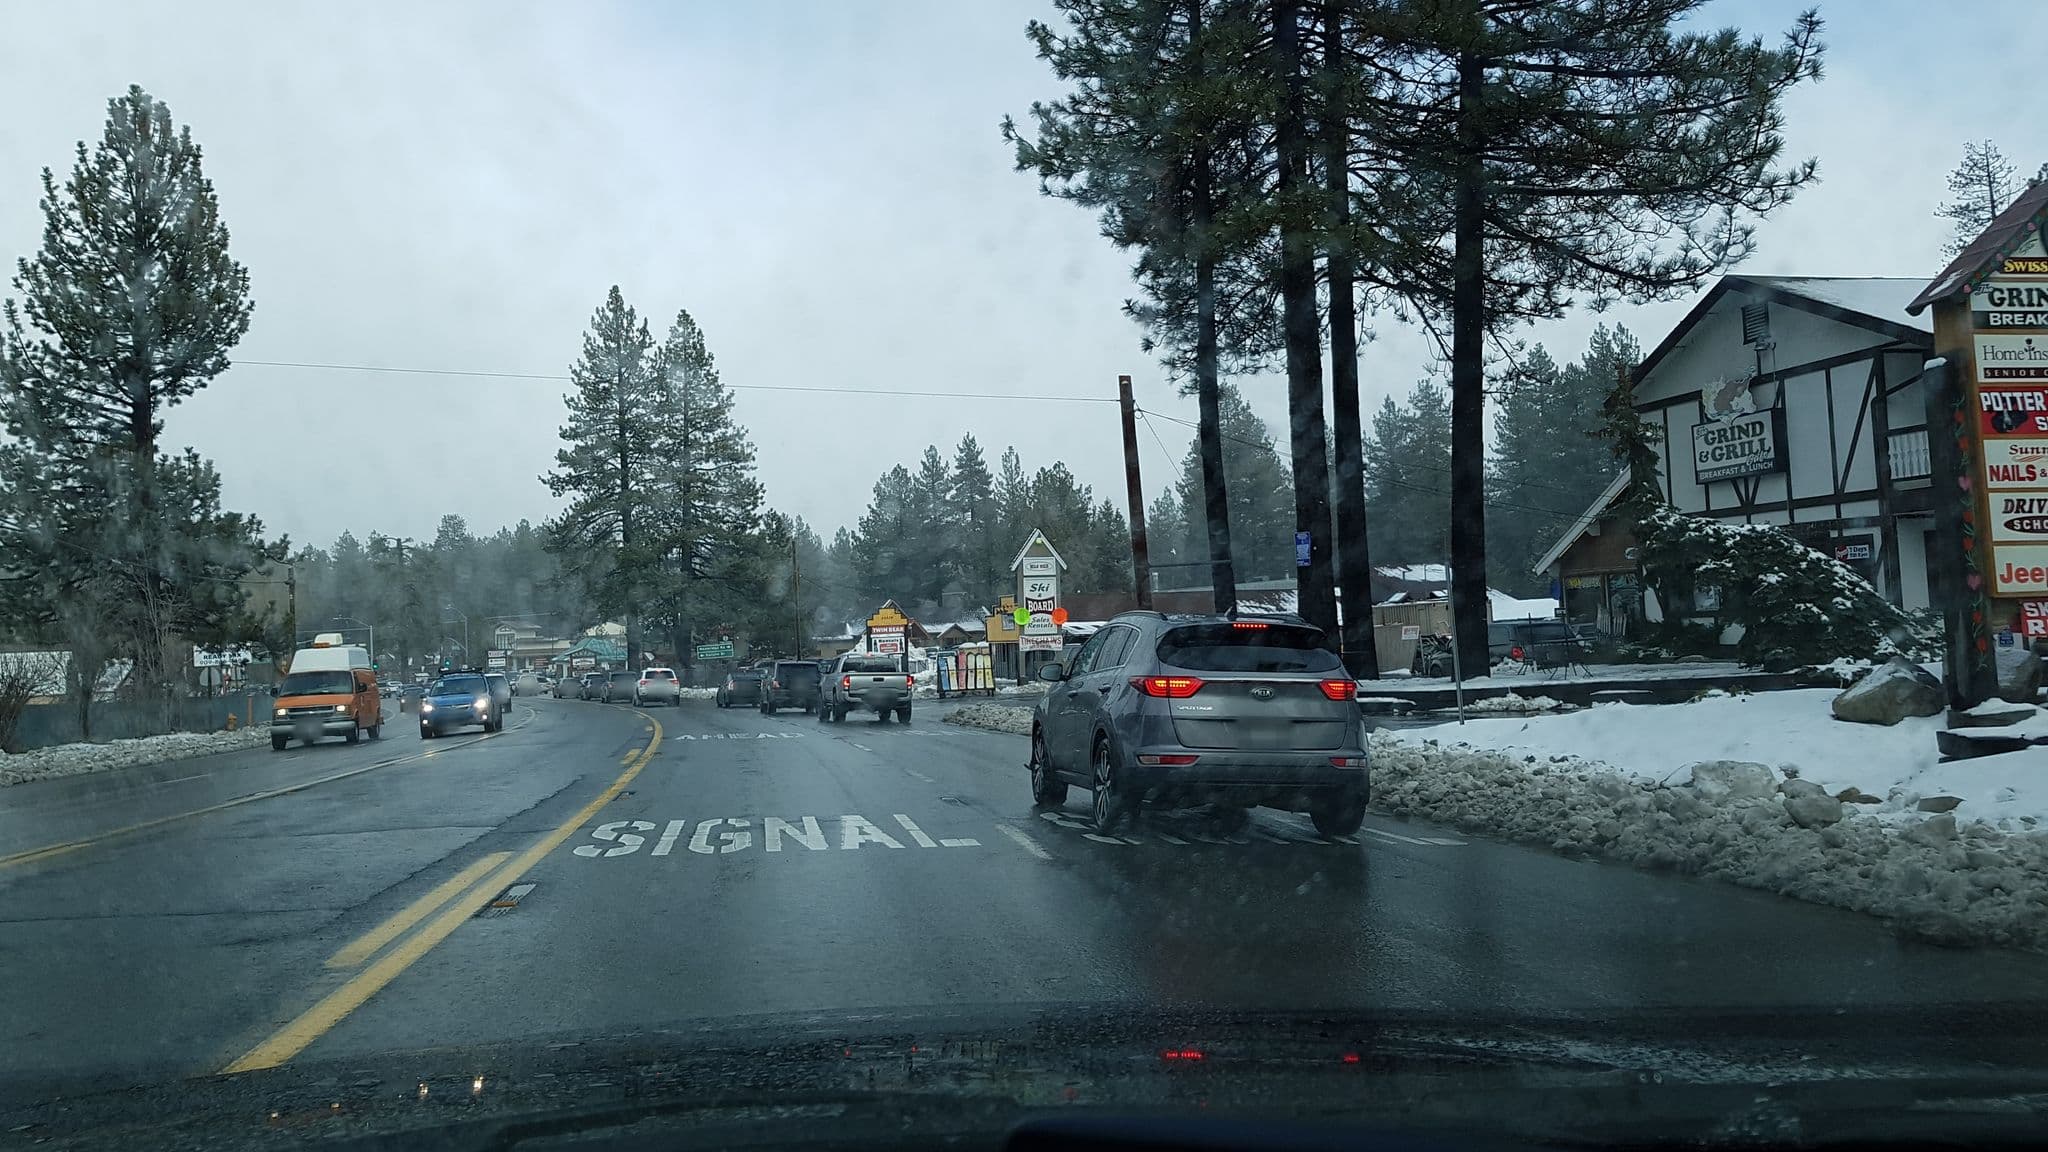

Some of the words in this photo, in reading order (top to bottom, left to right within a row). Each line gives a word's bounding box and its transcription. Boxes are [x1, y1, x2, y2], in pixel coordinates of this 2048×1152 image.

[2003, 259, 2048, 272] SWISS
[1985, 369, 2035, 377] SENIOR
[2034, 416, 2048, 431] S
[1704, 420, 1764, 446] GRIND
[1699, 450, 1709, 464] &
[1711, 437, 1771, 463] GRILL
[1700, 467, 1739, 480] BREAKFAST
[1749, 461, 1773, 472] LUNCH
[1988, 464, 2037, 482] NAILS
[2002, 498, 2048, 514] DRIV
[1999, 563, 2048, 588] Jee
[1029, 583, 1050, 593] Ski
[1027, 600, 1054, 612] BOARD
[1032, 616, 1050, 624] Sales
[675, 732, 805, 741] AHEAD
[572, 814, 983, 858] SIGNAL
